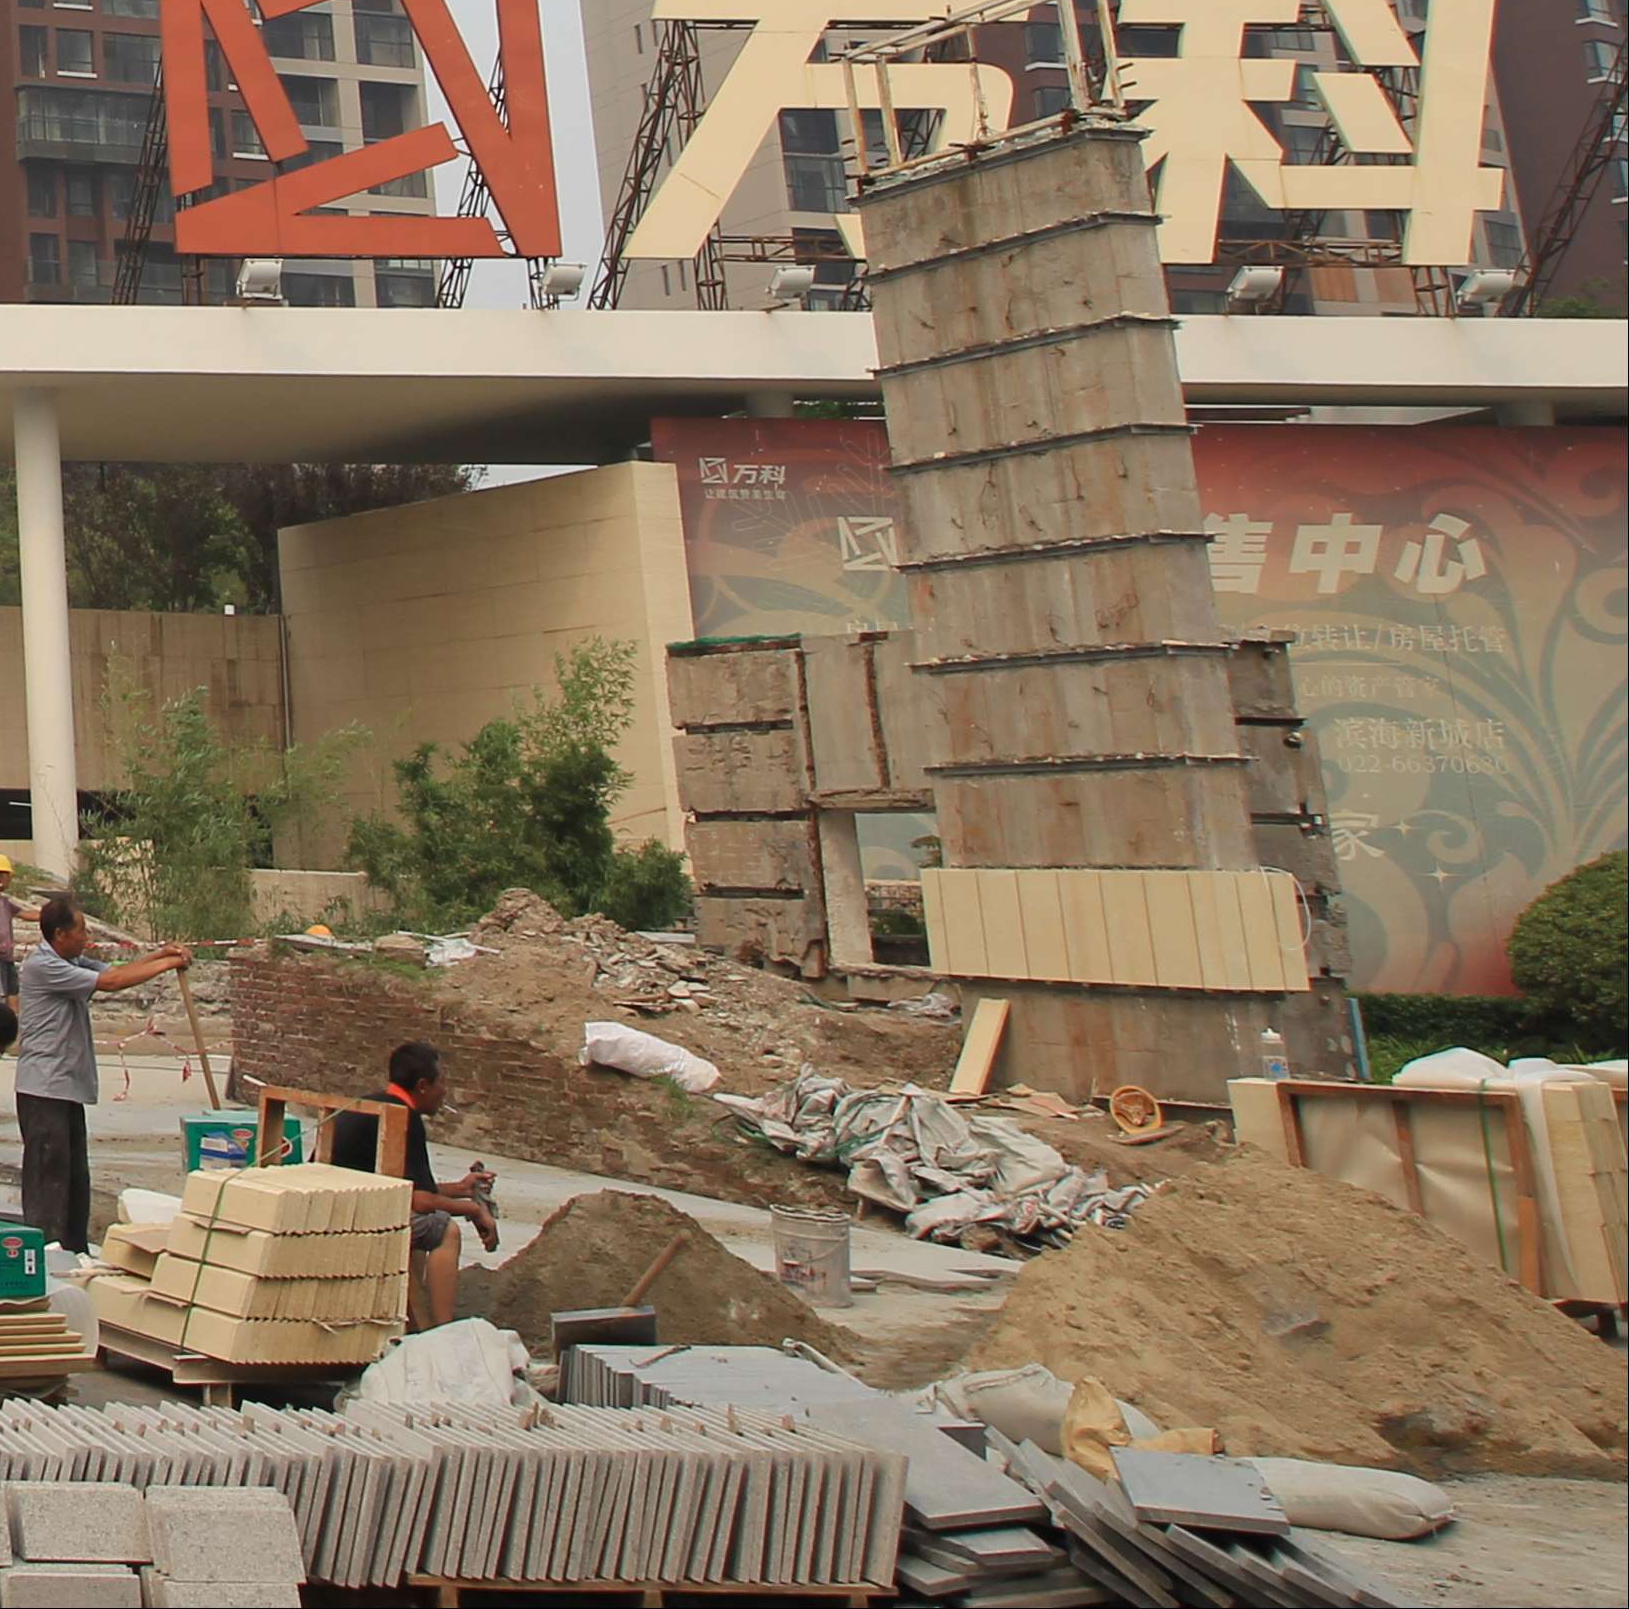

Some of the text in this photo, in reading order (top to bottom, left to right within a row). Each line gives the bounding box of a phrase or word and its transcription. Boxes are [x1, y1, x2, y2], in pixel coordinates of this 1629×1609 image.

[732, 464, 787, 485] 万科
[1333, 717, 1505, 750] 滨海新城店
